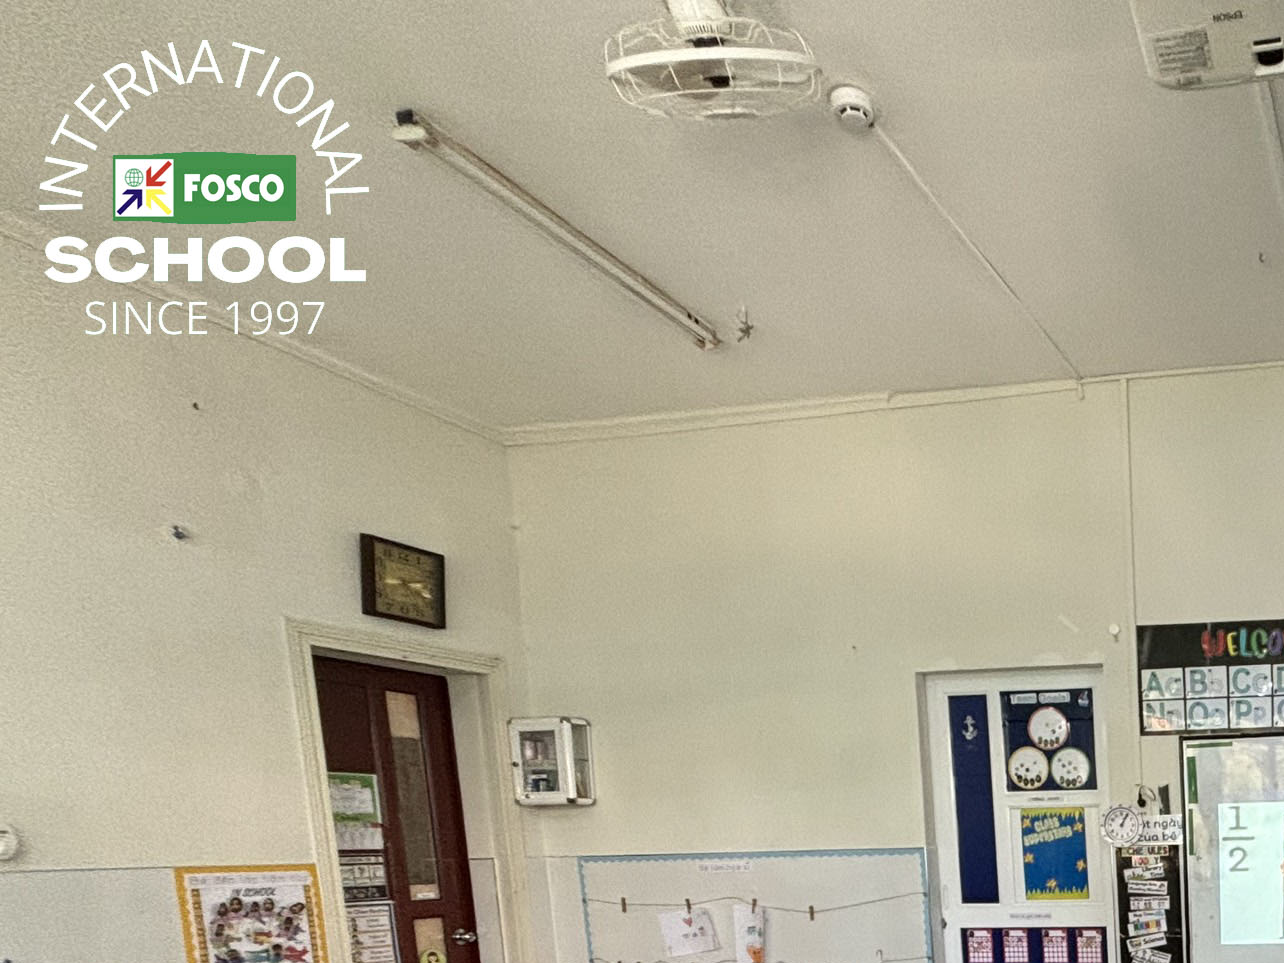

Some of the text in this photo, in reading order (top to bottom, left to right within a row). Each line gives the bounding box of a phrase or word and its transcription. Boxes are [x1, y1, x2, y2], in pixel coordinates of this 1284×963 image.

[1228, 806, 1248, 830] 1
[1126, 845, 1169, 856] CHEULES
[1229, 848, 1249, 872] 2
